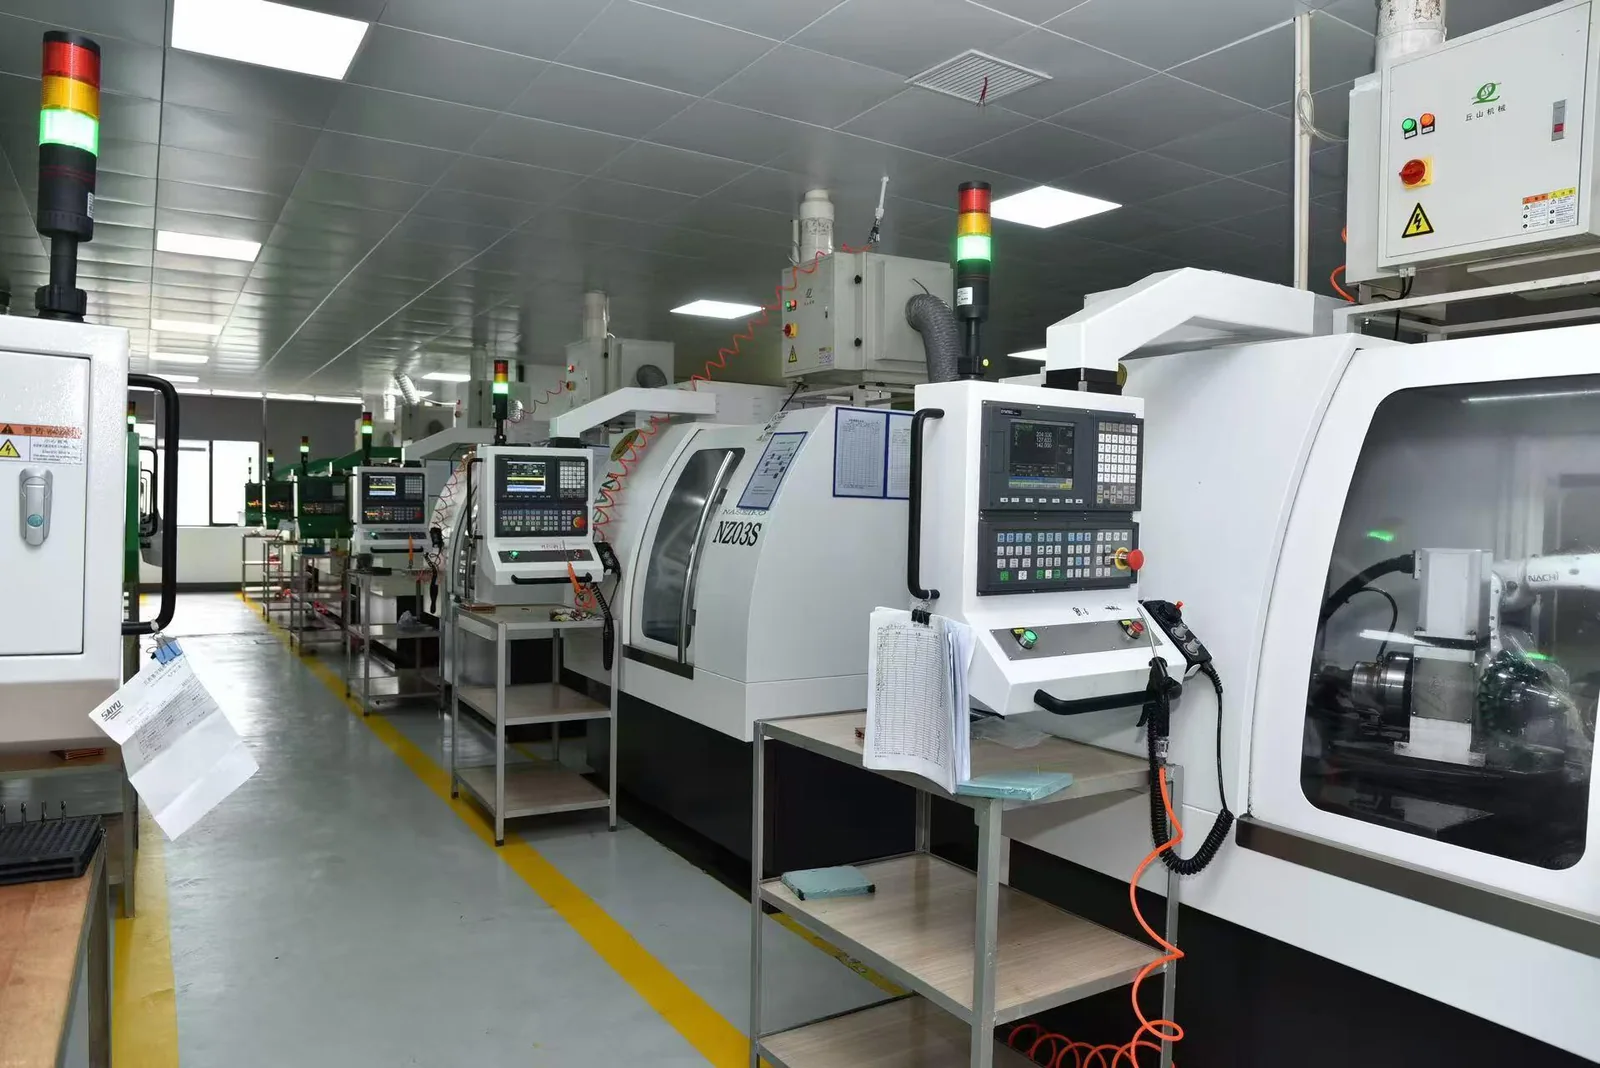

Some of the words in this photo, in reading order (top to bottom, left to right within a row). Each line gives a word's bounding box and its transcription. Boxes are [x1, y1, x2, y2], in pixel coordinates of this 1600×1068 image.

[1465, 104, 1507, 122] 丘山机械
[712, 520, 763, 547] NZ03S
[1527, 571, 1559, 582] NACHI
[101, 700, 122, 719] SAIYU
